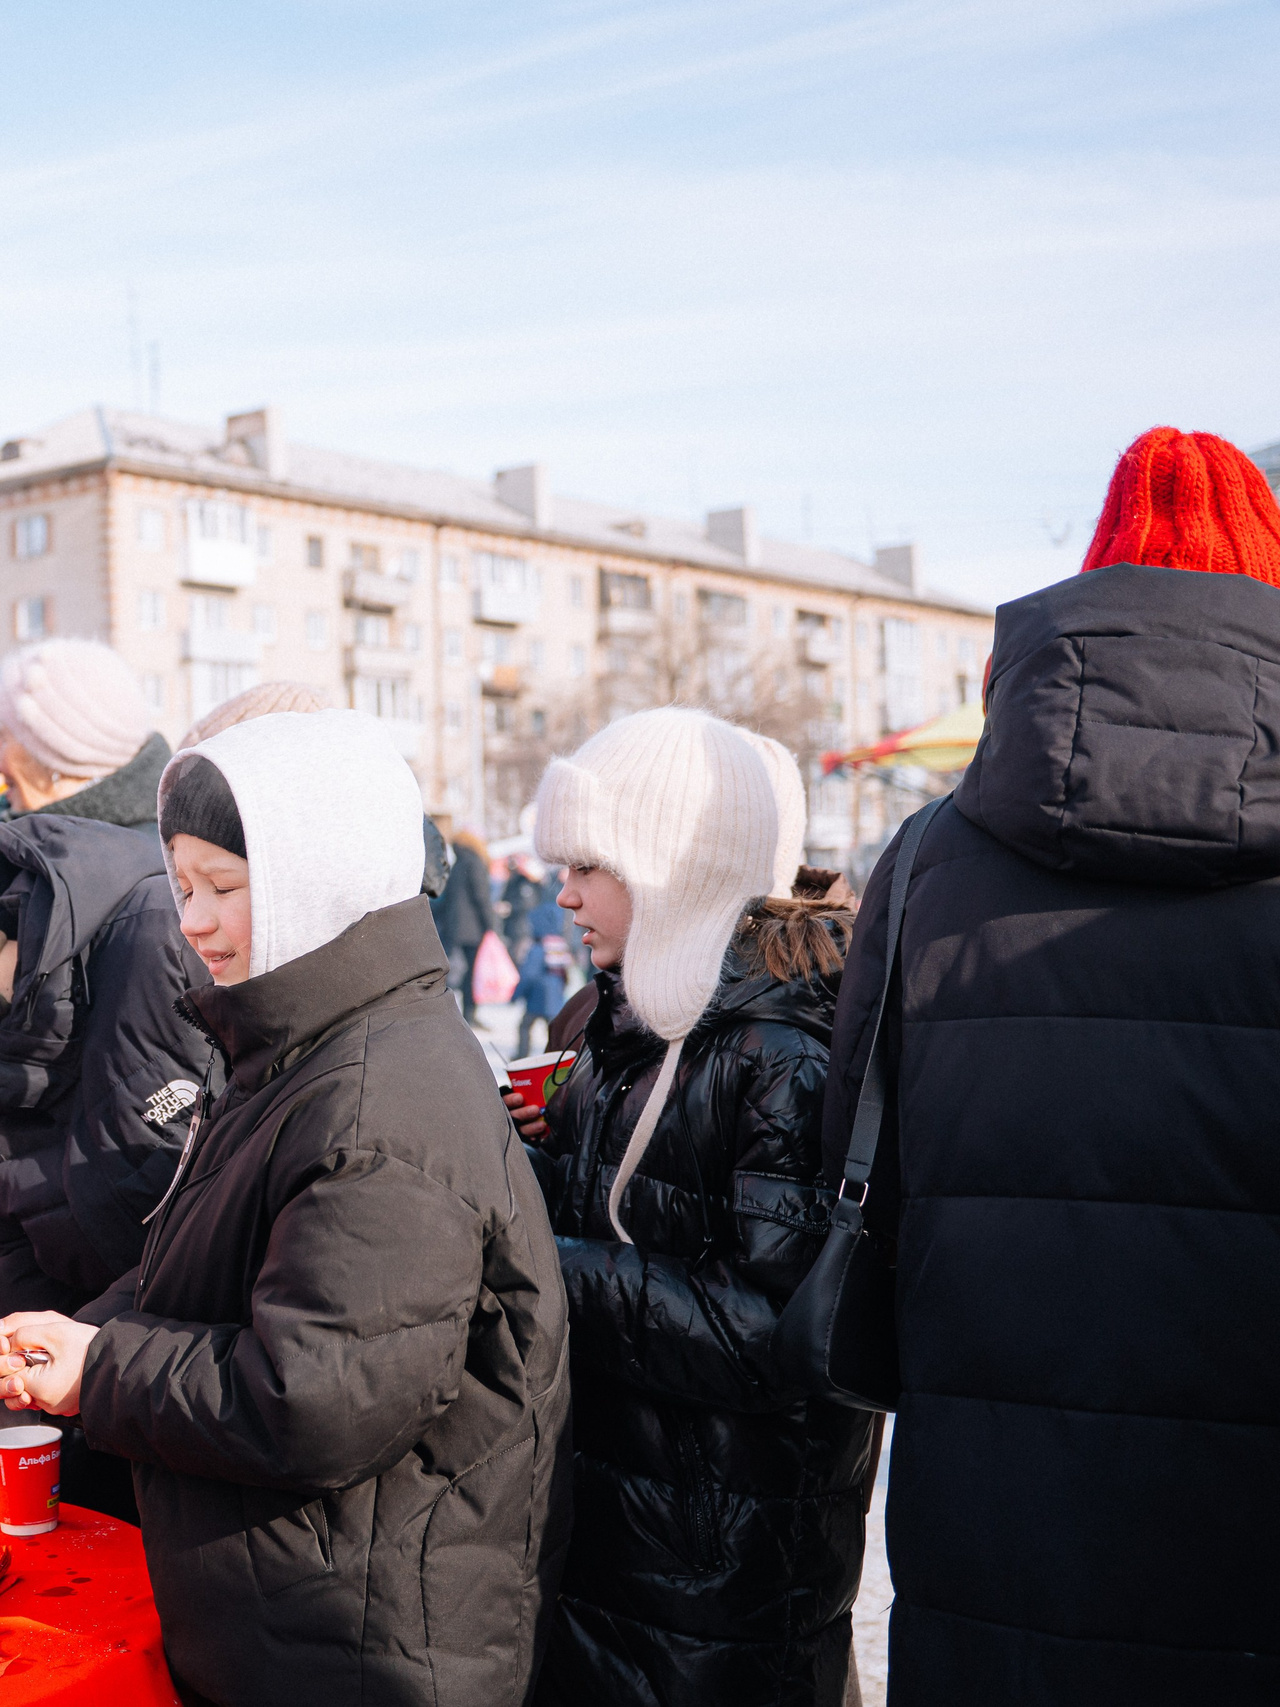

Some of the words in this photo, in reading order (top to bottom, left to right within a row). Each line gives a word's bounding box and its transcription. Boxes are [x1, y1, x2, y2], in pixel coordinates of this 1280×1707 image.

[145, 1086, 173, 1106] THE
[140, 1093, 181, 1124] NORTH
[155, 1101, 186, 1126] FACE
[18, 1454, 51, 1467] Альфа
